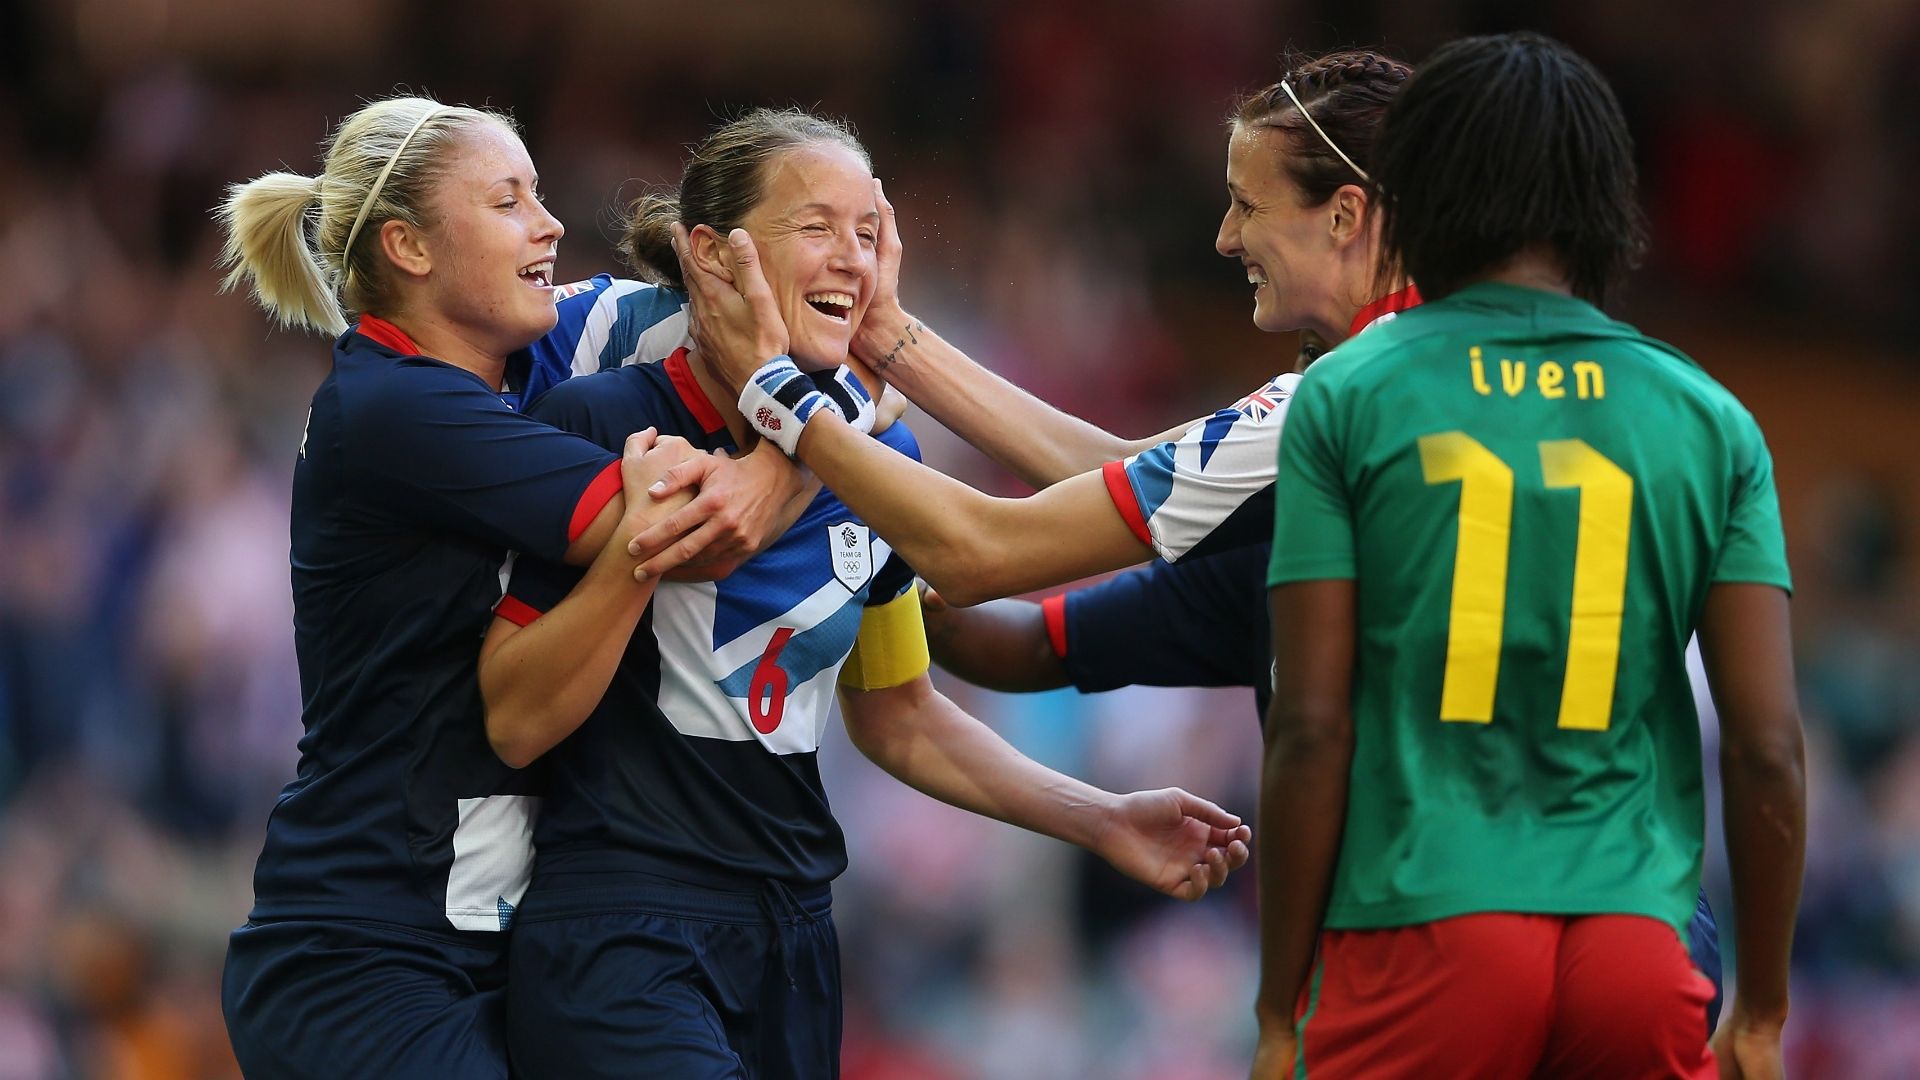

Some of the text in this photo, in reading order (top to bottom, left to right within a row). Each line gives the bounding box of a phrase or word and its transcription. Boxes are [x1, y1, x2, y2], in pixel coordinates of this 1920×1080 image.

[1469, 346, 1605, 399] iven
[1417, 430, 1633, 731] 11
[748, 627, 796, 734] 6
